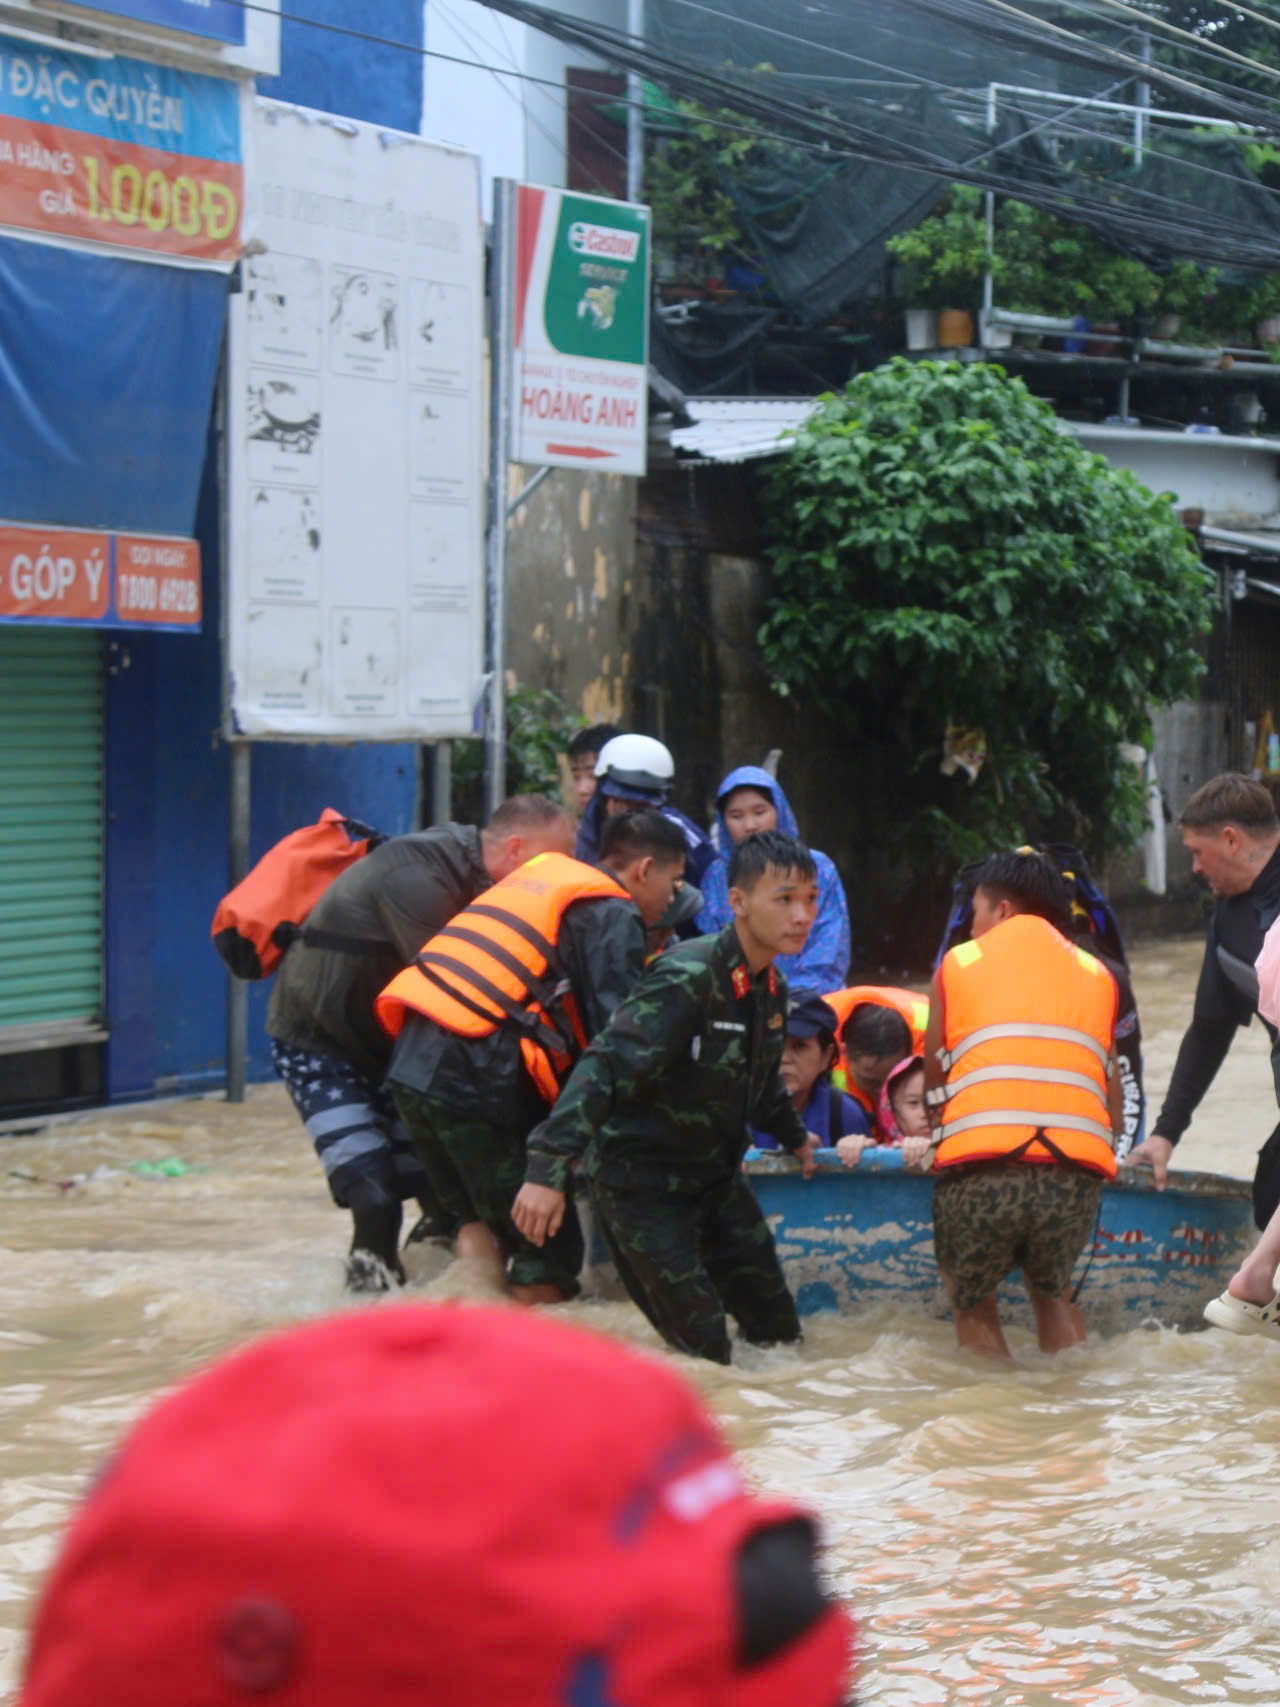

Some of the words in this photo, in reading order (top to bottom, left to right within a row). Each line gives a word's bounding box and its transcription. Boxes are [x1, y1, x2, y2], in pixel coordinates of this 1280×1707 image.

[8, 55, 80, 114] ĐẶC
[86, 73, 184, 134] QUYỀN
[520, 383, 593, 425] HOÀNG
[594, 394, 638, 429] ANH
[9, 544, 77, 601] GÓP
[83, 547, 105, 603] Ý
